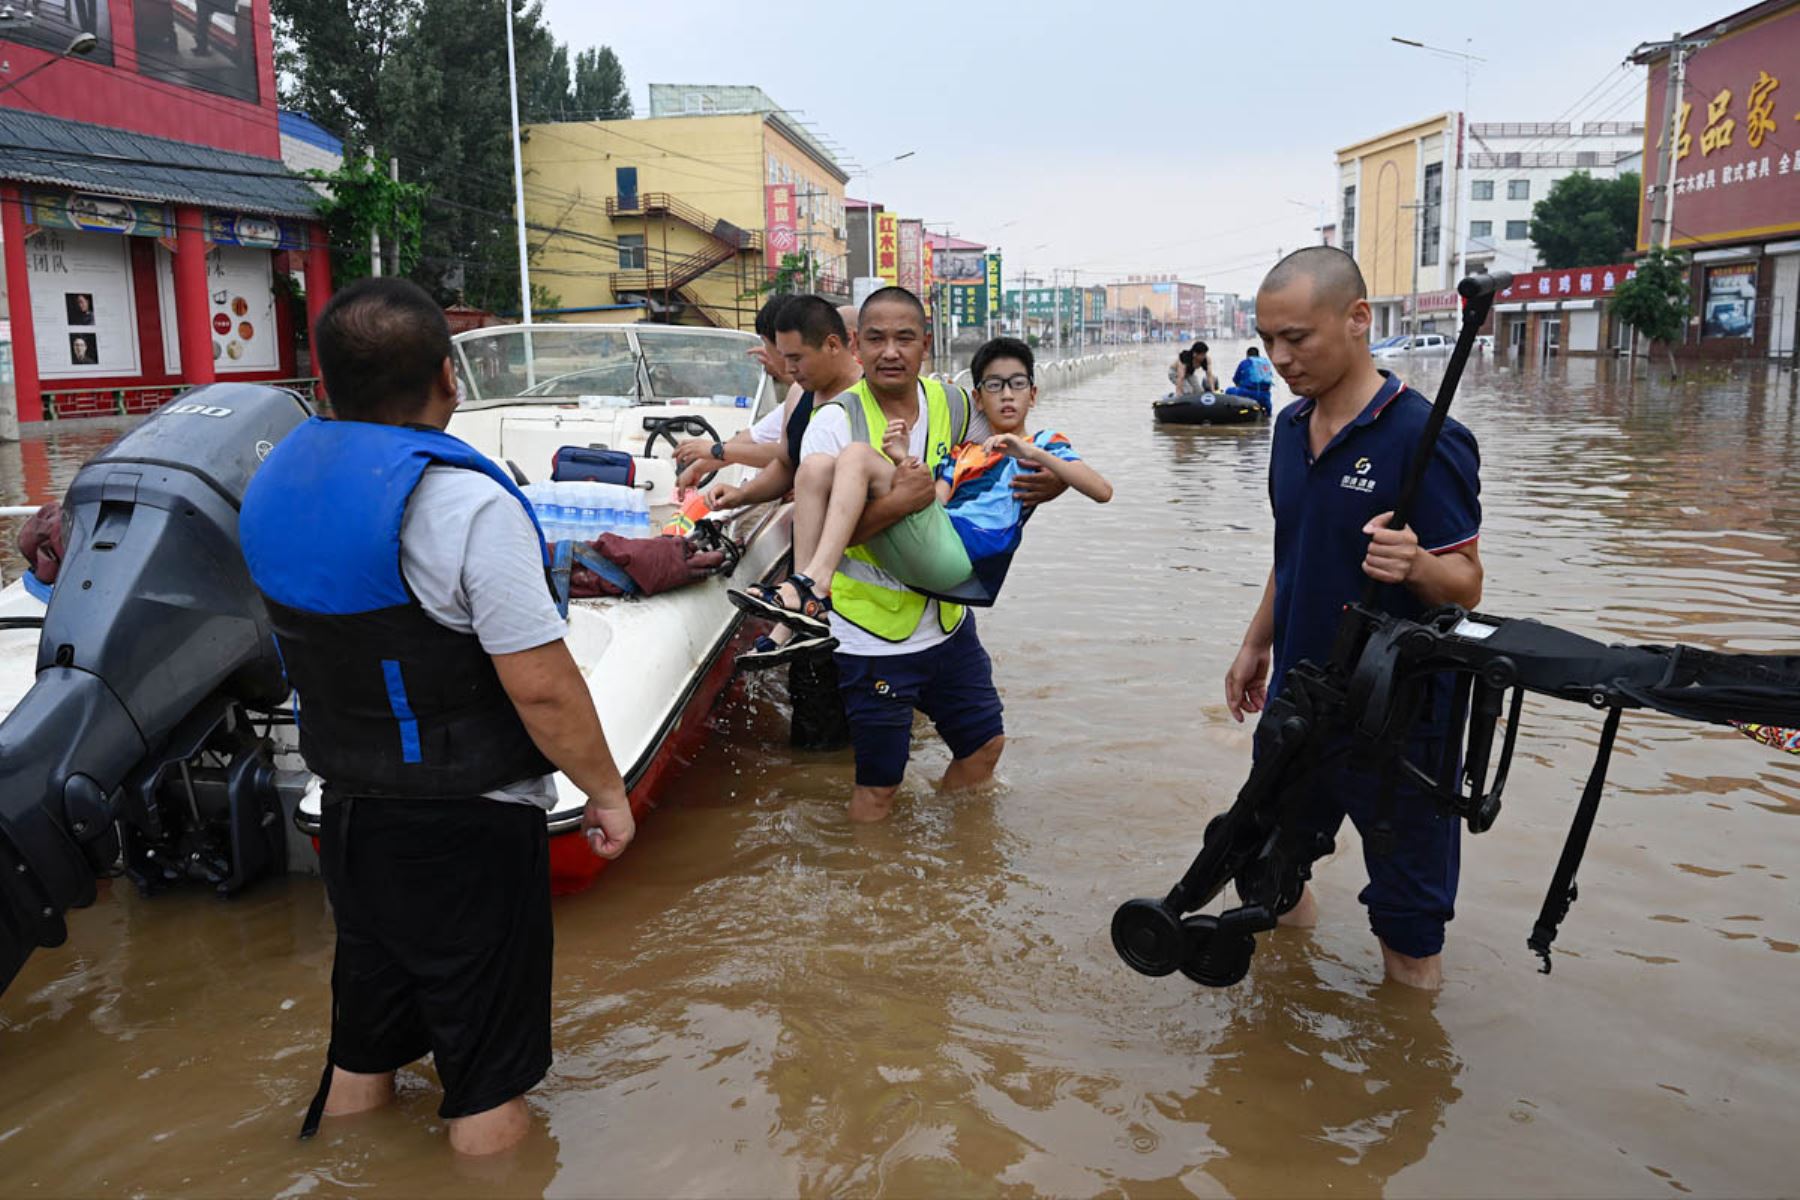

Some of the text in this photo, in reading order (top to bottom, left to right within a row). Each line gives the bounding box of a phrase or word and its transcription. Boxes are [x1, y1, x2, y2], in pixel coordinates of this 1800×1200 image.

[1656, 70, 1800, 161] 名品家
[27, 253, 68, 274] 团队
[160, 404, 233, 418] 100
